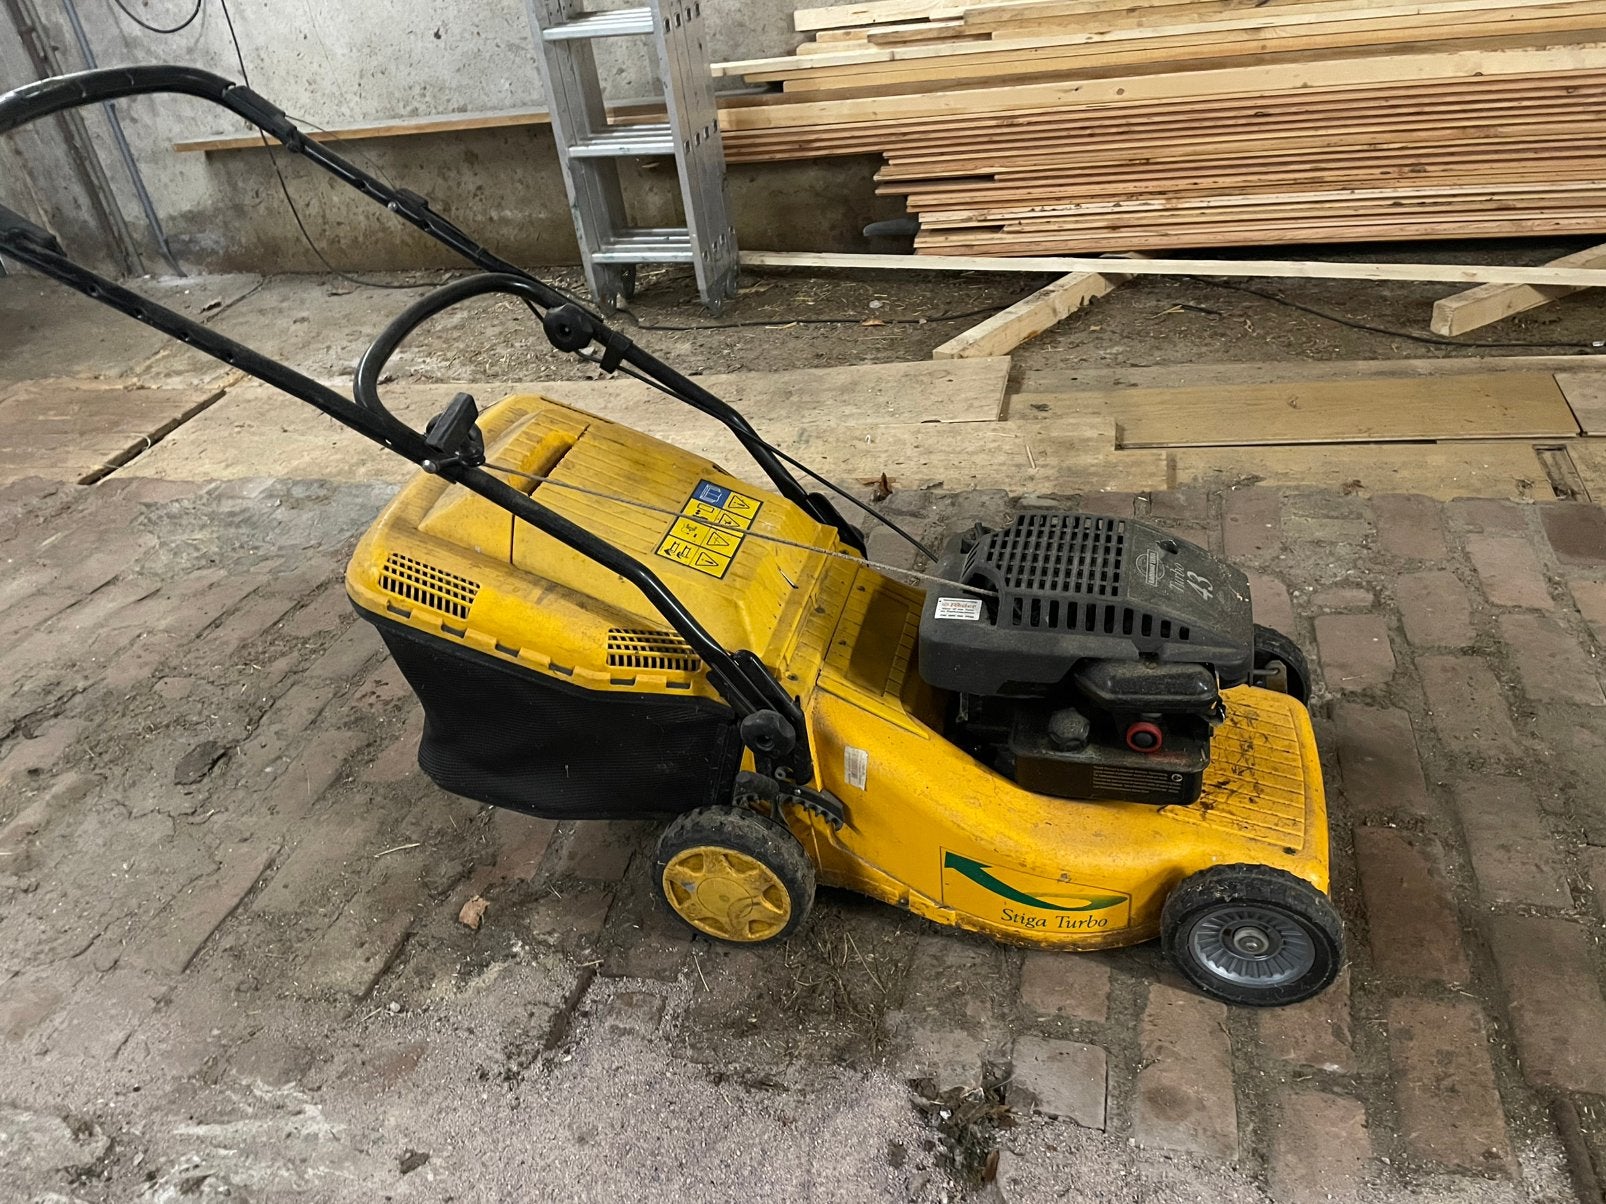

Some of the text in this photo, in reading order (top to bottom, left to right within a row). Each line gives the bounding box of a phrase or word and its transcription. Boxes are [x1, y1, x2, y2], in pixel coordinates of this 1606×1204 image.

[1169, 562, 1185, 593] Turbo
[1186, 570, 1214, 600] 43
[1001, 908, 1108, 929] Stiga Turbo
